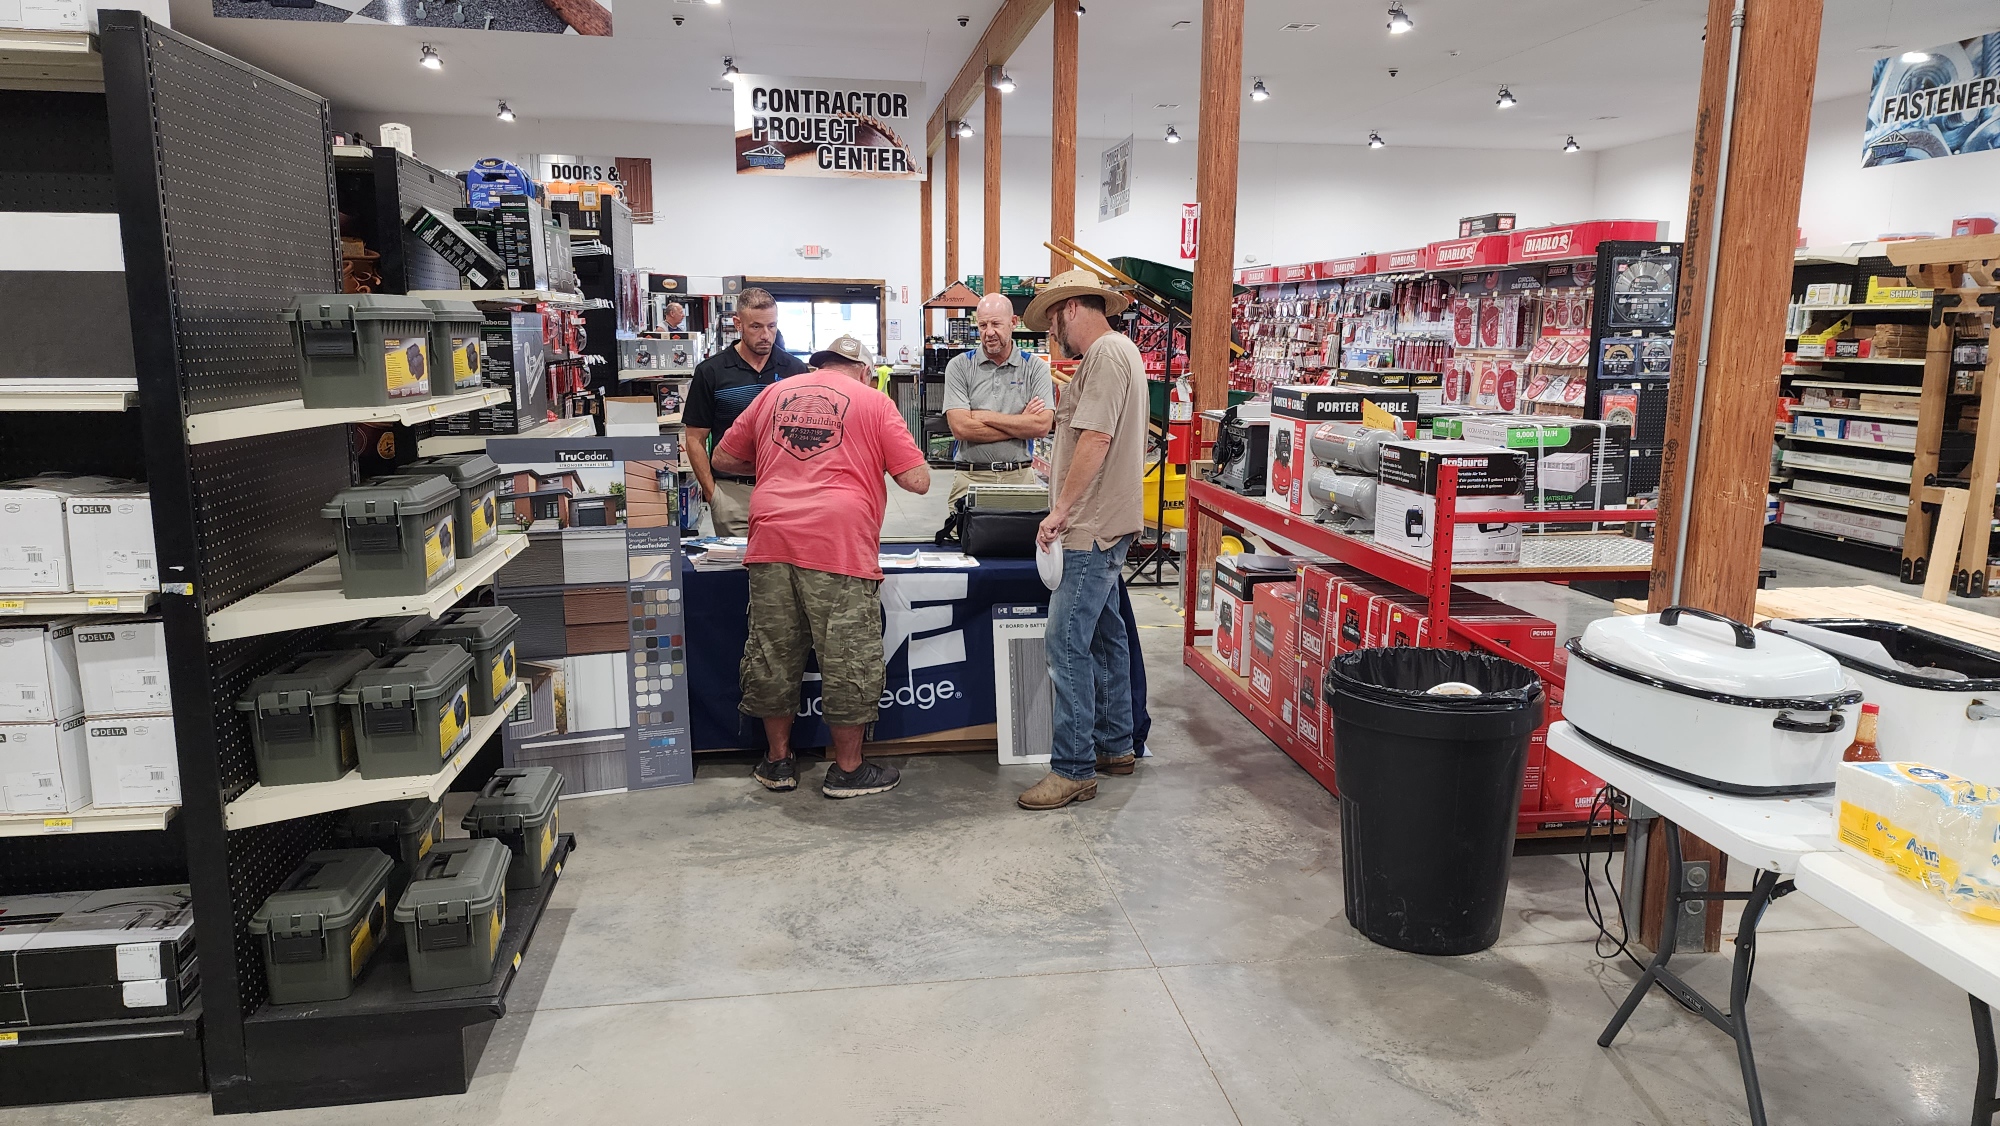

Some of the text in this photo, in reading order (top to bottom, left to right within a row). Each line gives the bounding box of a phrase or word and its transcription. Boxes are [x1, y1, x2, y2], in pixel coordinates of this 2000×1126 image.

[752, 87, 908, 118] CONTRACTOR
[1883, 78, 2000, 124] FASTENER
[753, 116, 859, 144] PROJECT
[817, 145, 908, 172] CENTER
[551, 163, 619, 181] DOORS &
[1185, 209, 1195, 217] FIRE
[806, 245, 819, 256] EXIT
[1525, 236, 1558, 253] DIABLO
[1390, 254, 1411, 267] DIABLO
[1438, 247, 1467, 262] DIABLO
[1334, 262, 1350, 274] DIABLO
[1889, 290, 1919, 299] SHIMS
[1678, 285, 1693, 323] PSL
[1836, 344, 1859, 354] SHIMS
[1273, 395, 1288, 408] PORTER
[1317, 402, 1359, 413] PORTER
[805, 416, 842, 430] Building
[82, 505, 111, 514] DELTA
[87, 633, 115, 642] DELTA
[1302, 630, 1321, 654] SENCO
[1252, 664, 1271, 695] SENCO
[100, 728, 128, 737] DELTA
[1299, 716, 1318, 740] SENCO
